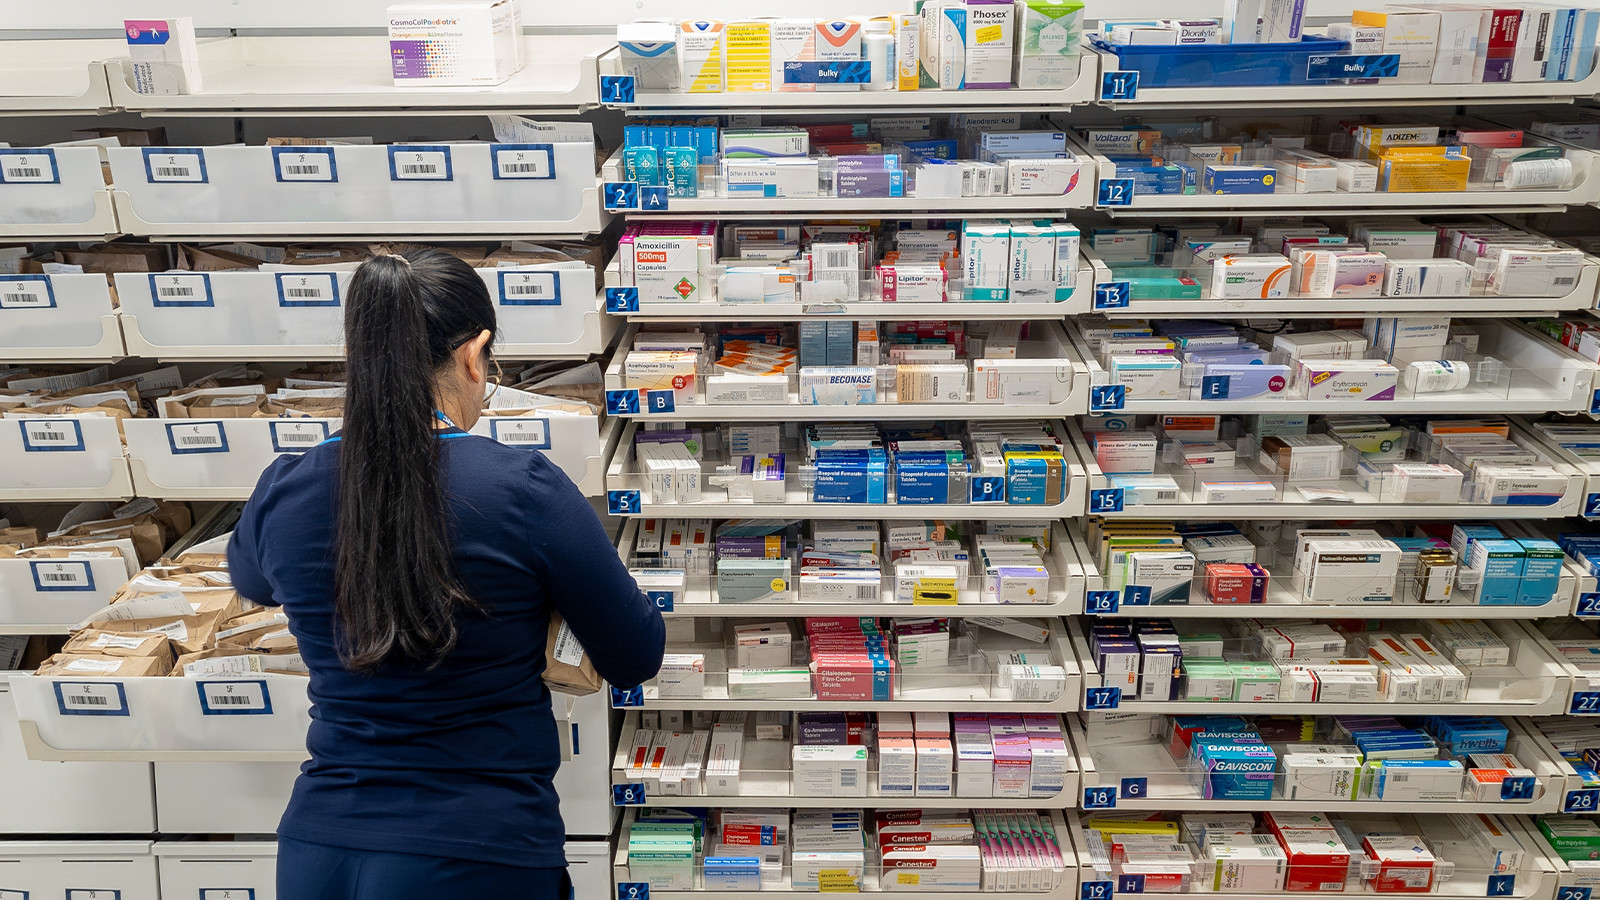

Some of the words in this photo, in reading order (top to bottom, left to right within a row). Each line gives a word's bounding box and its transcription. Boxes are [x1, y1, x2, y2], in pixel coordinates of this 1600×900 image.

[973, 10, 1004, 18] Phosex
[1181, 27, 1215, 38] Dioralyte
[818, 69, 839, 78] Bulky
[1343, 64, 1364, 73] Bulky
[614, 82, 621, 98] 1
[1113, 78, 1125, 92] 11
[1095, 134, 1132, 142] Voltarol
[616, 189, 625, 202] 2
[1108, 186, 1123, 199] 12
[650, 194, 660, 205] A
[639, 253, 665, 261] 500mg
[898, 275, 923, 283] Lipitor
[1394, 268, 1404, 296] Dymista
[618, 293, 627, 306] 3
[1104, 289, 1120, 303] 13
[830, 376, 872, 384] BECONASE
[1212, 383, 1219, 394] E
[618, 396, 627, 409] 4
[657, 397, 666, 408] B
[1101, 392, 1115, 404] 14
[984, 483, 992, 494] B
[620, 496, 629, 507] 5
[1100, 495, 1115, 507] 15
[656, 596, 665, 607] C
[1095, 595, 1110, 608] 16
[1134, 593, 1141, 603] F
[623, 691, 632, 702] 7
[1095, 693, 1109, 704] 17
[1579, 697, 1598, 709] 27
[1460, 738, 1498, 749] Kwells
[1215, 762, 1273, 772] GAVISCON
[1129, 784, 1139, 795] G
[1513, 782, 1523, 792] H
[625, 789, 634, 800] 8
[1092, 792, 1108, 804] 18
[1572, 795, 1591, 807] 28
[1225, 862, 1234, 888] Buscopan
[1090, 886, 1105, 897] 19
[1127, 881, 1136, 891] H
[1497, 881, 1504, 891] K
[629, 887, 637, 897] 9
